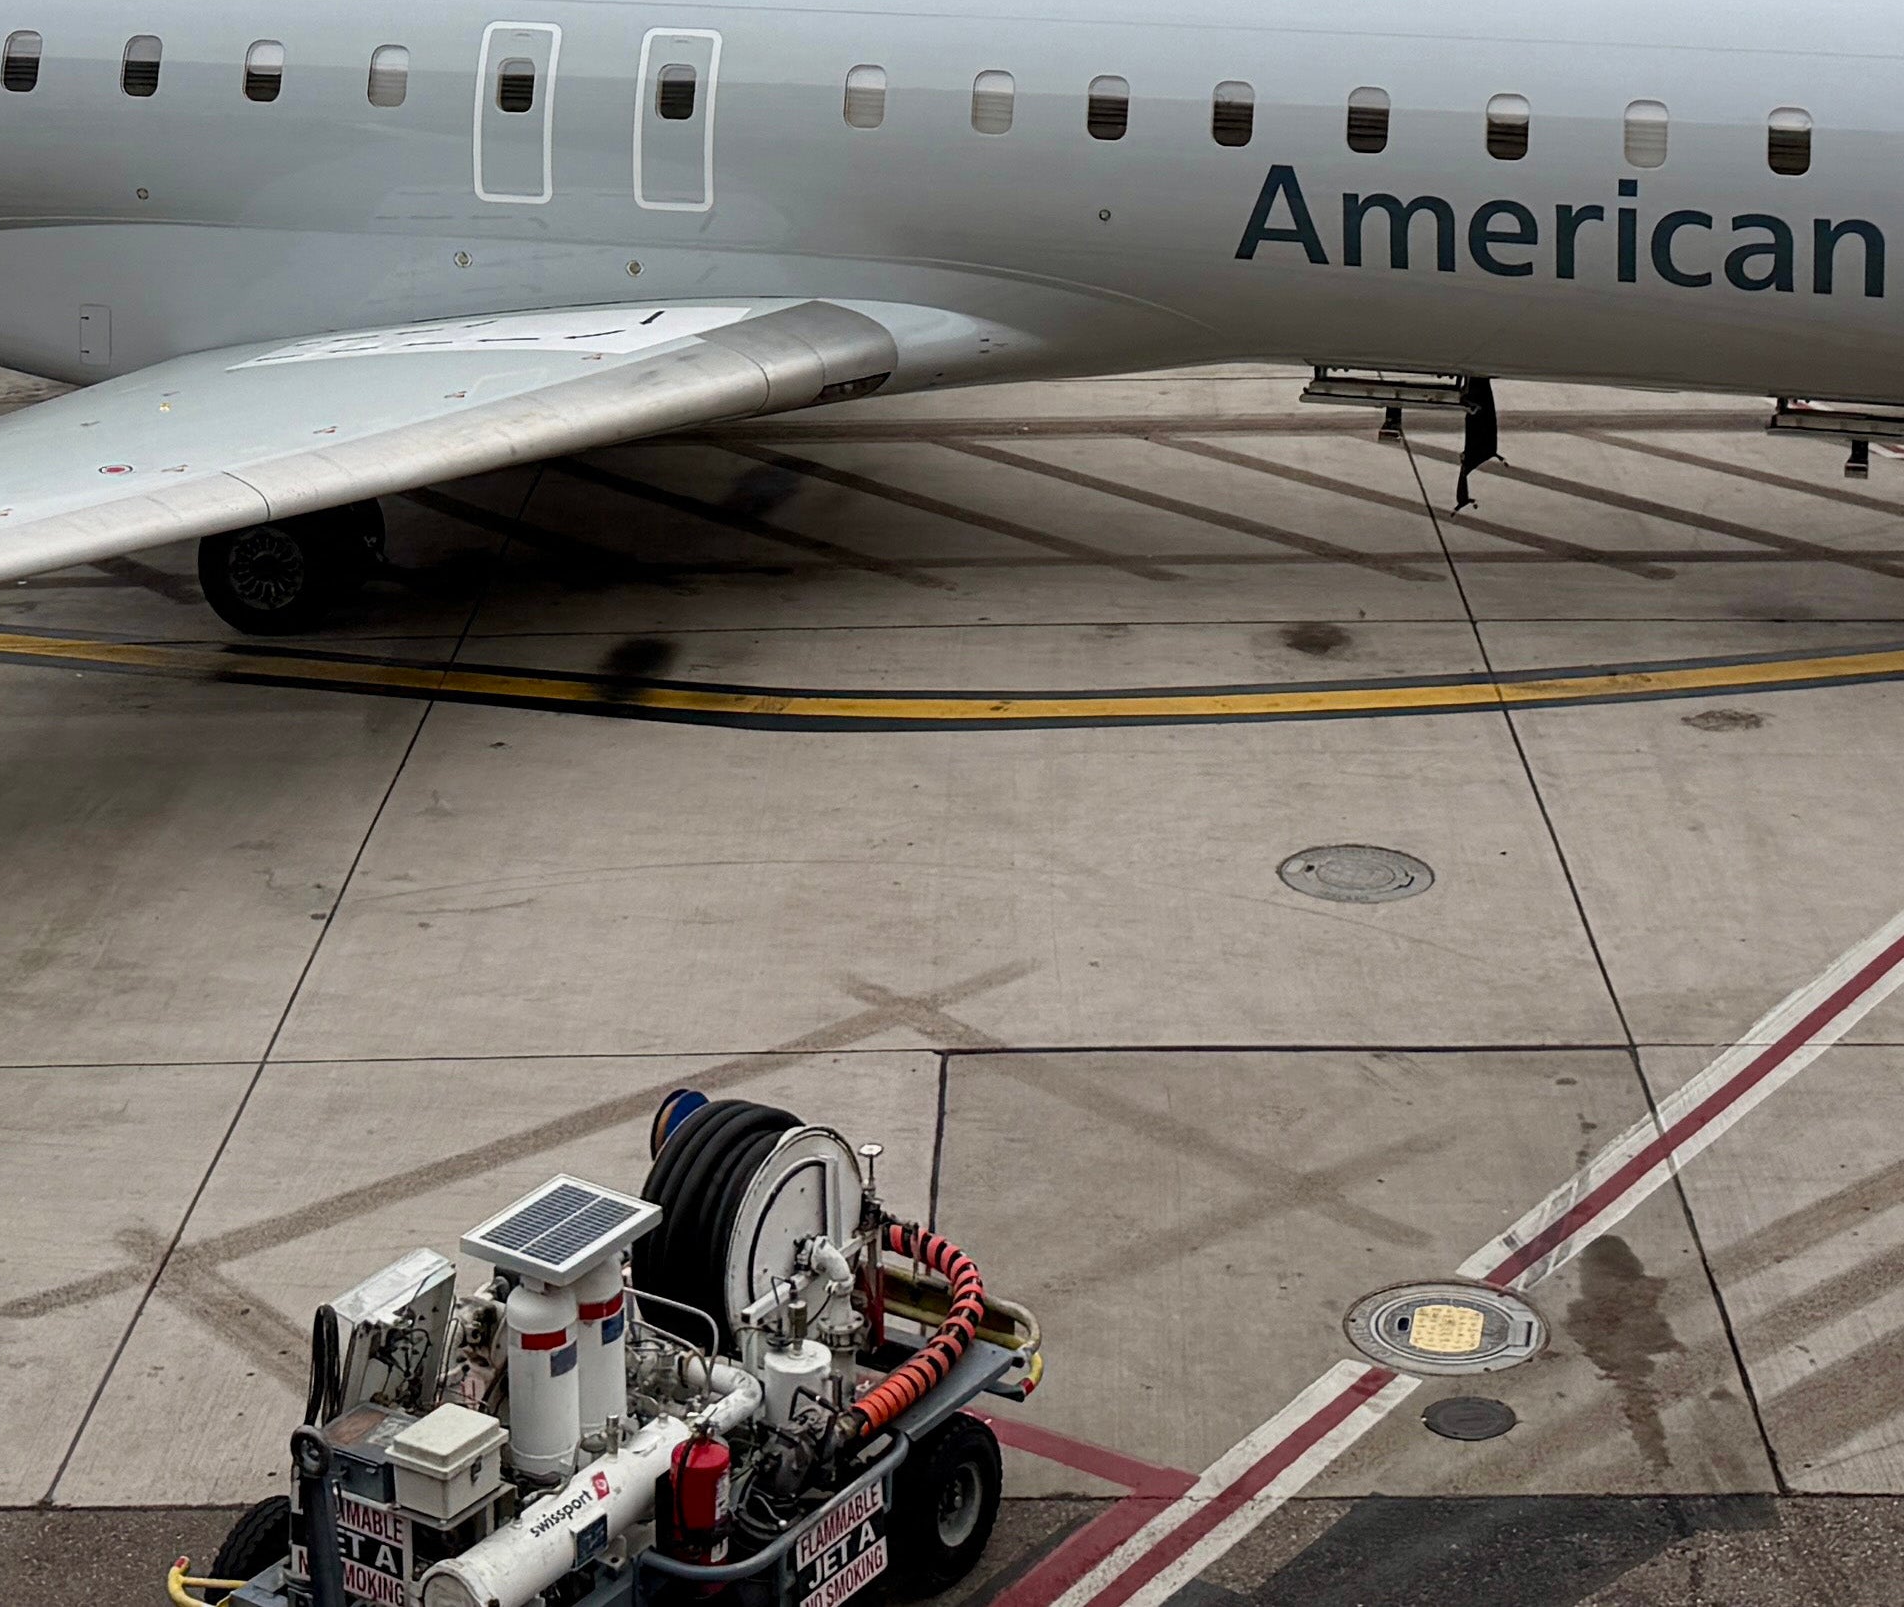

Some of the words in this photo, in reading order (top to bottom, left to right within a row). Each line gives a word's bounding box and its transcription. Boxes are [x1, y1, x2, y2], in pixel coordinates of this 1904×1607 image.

[1234, 164, 1886, 298] American
[530, 1489, 593, 1538] swissport
[800, 1481, 879, 1564] FLAMMABLE
[375, 1544, 398, 1574] A
[808, 1534, 852, 1589] JET
[858, 1519, 876, 1552] A
[826, 1544, 884, 1607] SMOKING
